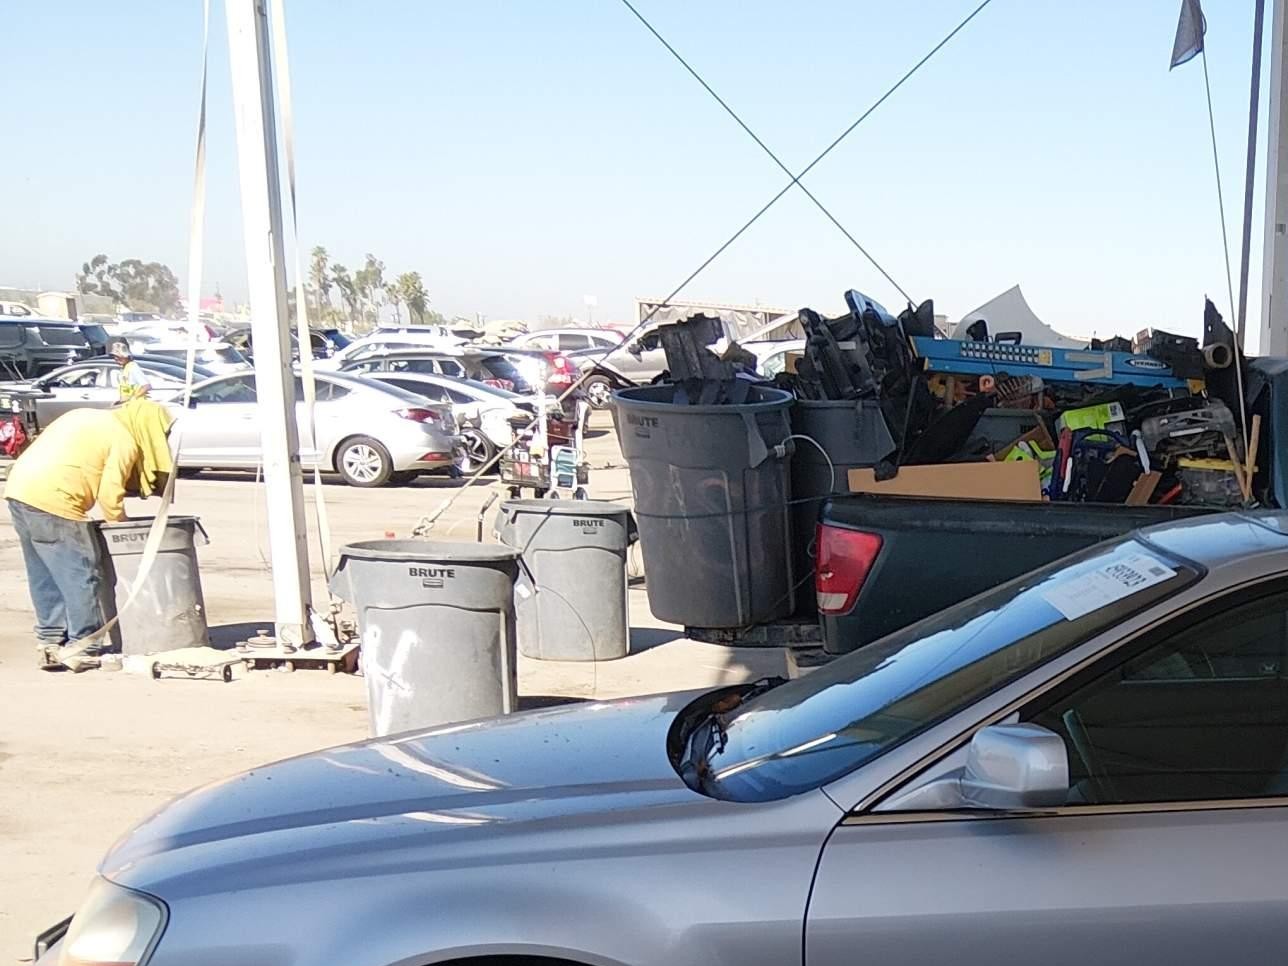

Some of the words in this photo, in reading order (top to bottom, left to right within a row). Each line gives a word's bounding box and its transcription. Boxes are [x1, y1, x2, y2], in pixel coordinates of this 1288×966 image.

[573, 519, 605, 527] BRUTE
[112, 532, 149, 543] BRUT
[409, 567, 455, 578] BRUTE
